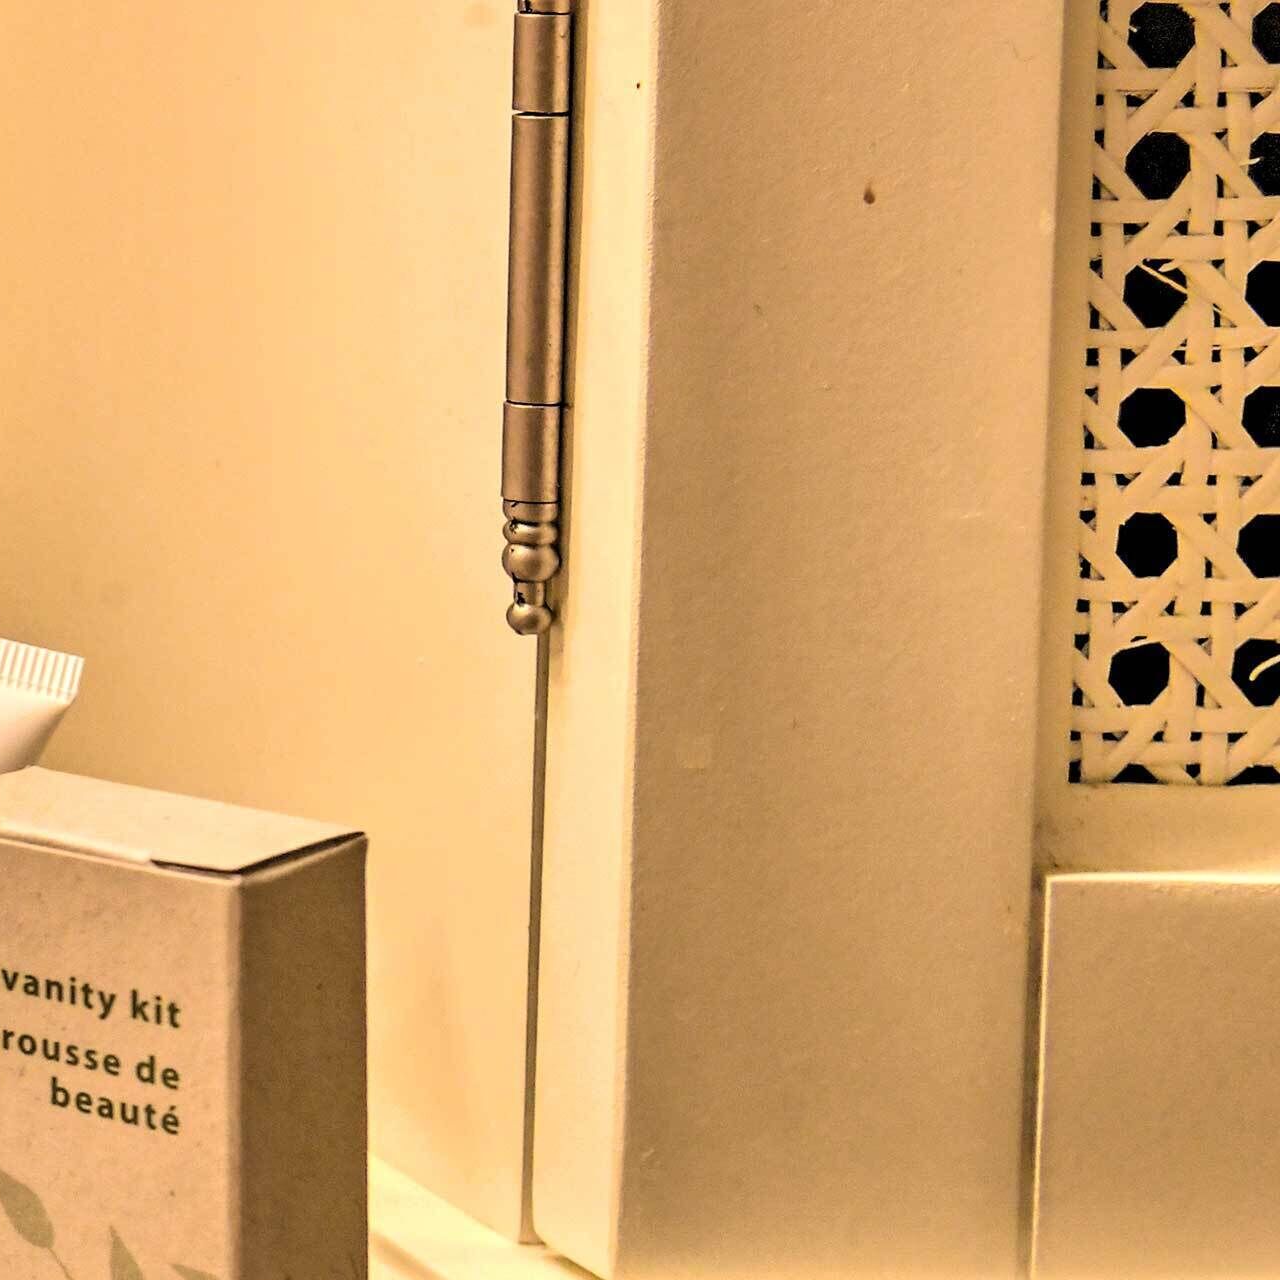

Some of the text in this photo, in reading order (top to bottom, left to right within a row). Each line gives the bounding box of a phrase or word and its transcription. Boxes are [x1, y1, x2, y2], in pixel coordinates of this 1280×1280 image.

[0, 968, 182, 1028] vanity kit
[135, 1055, 181, 1090] de
[49, 1077, 181, 1135] beauté
